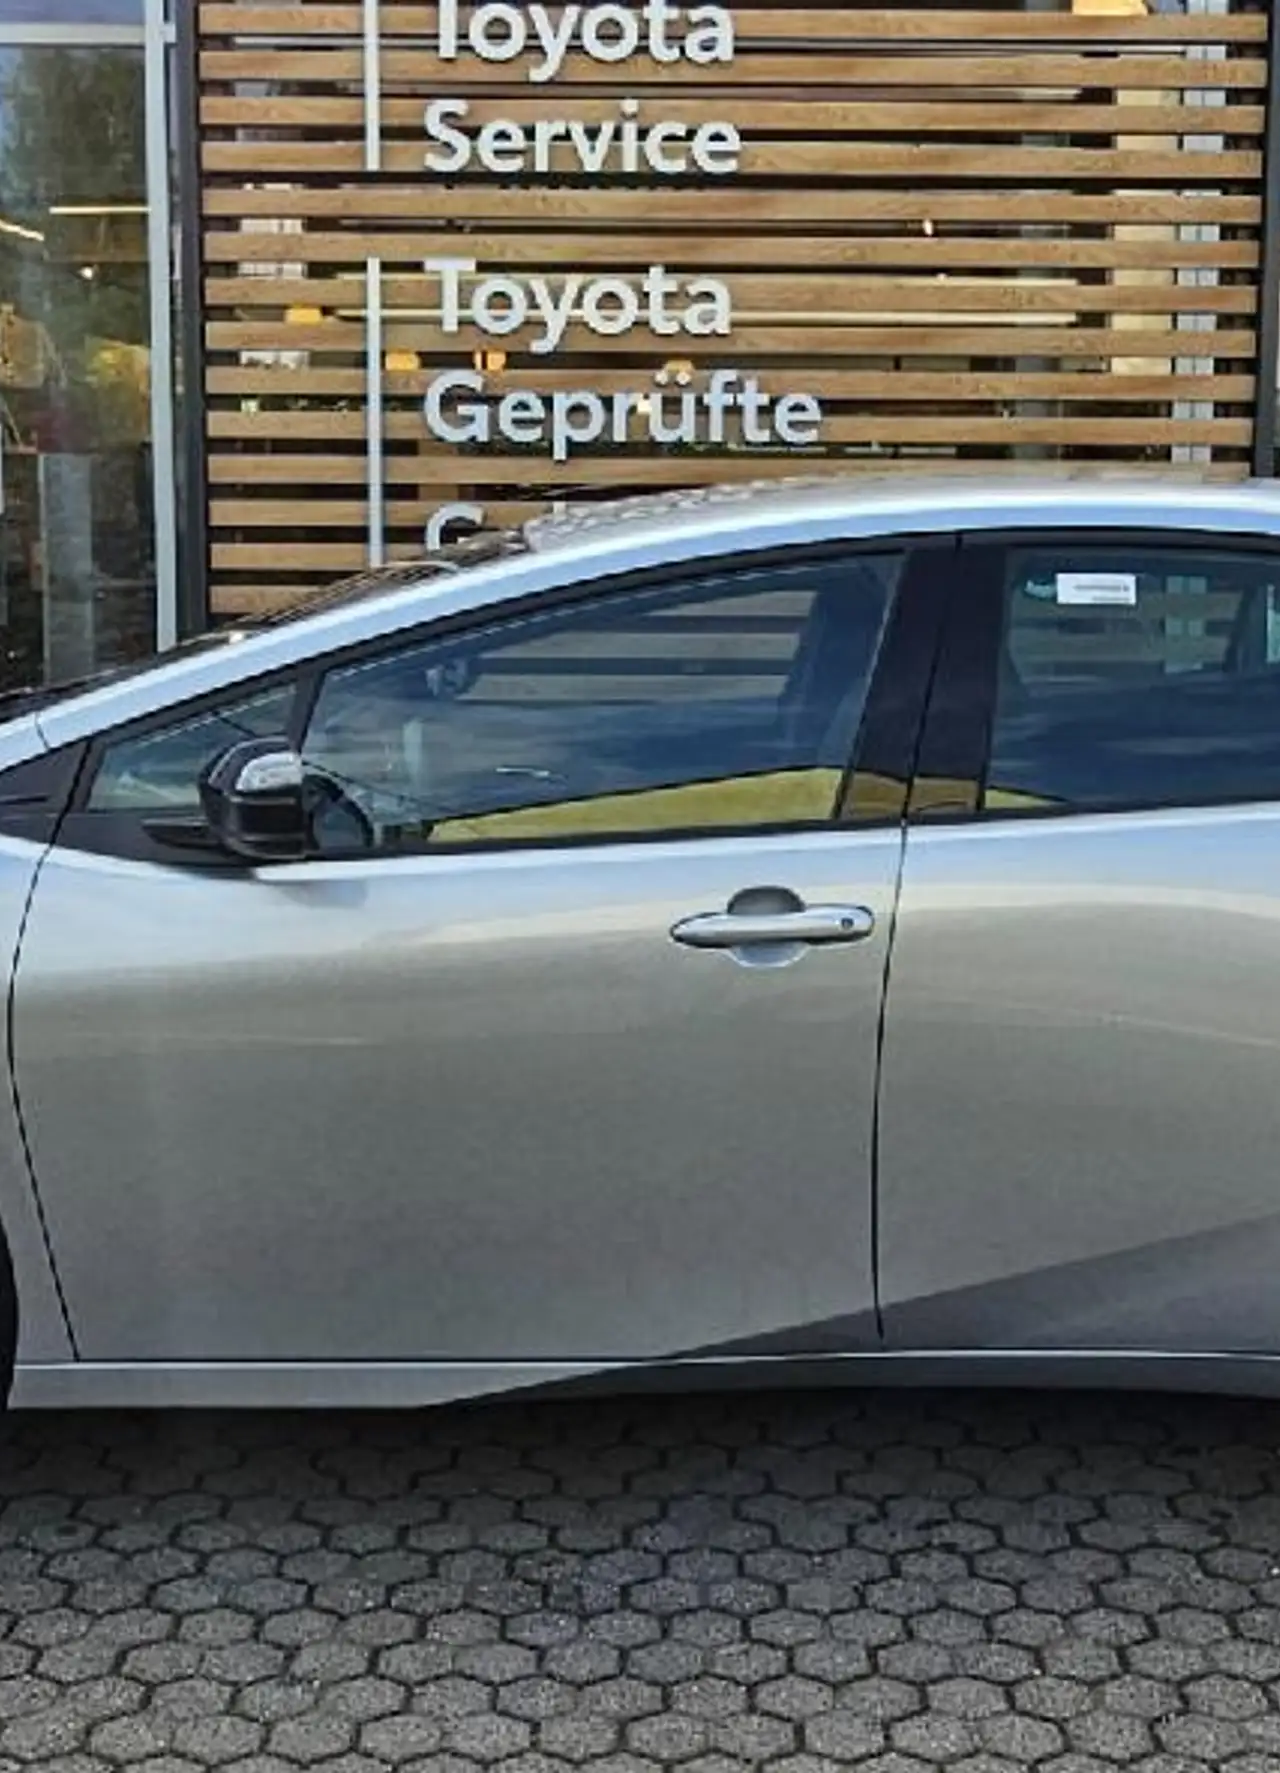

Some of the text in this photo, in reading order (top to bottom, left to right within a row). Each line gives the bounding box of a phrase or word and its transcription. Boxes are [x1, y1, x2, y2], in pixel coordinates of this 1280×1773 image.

[423, 98, 742, 175] Service
[423, 256, 732, 354] Toyota
[423, 368, 823, 461] Geprüfte
